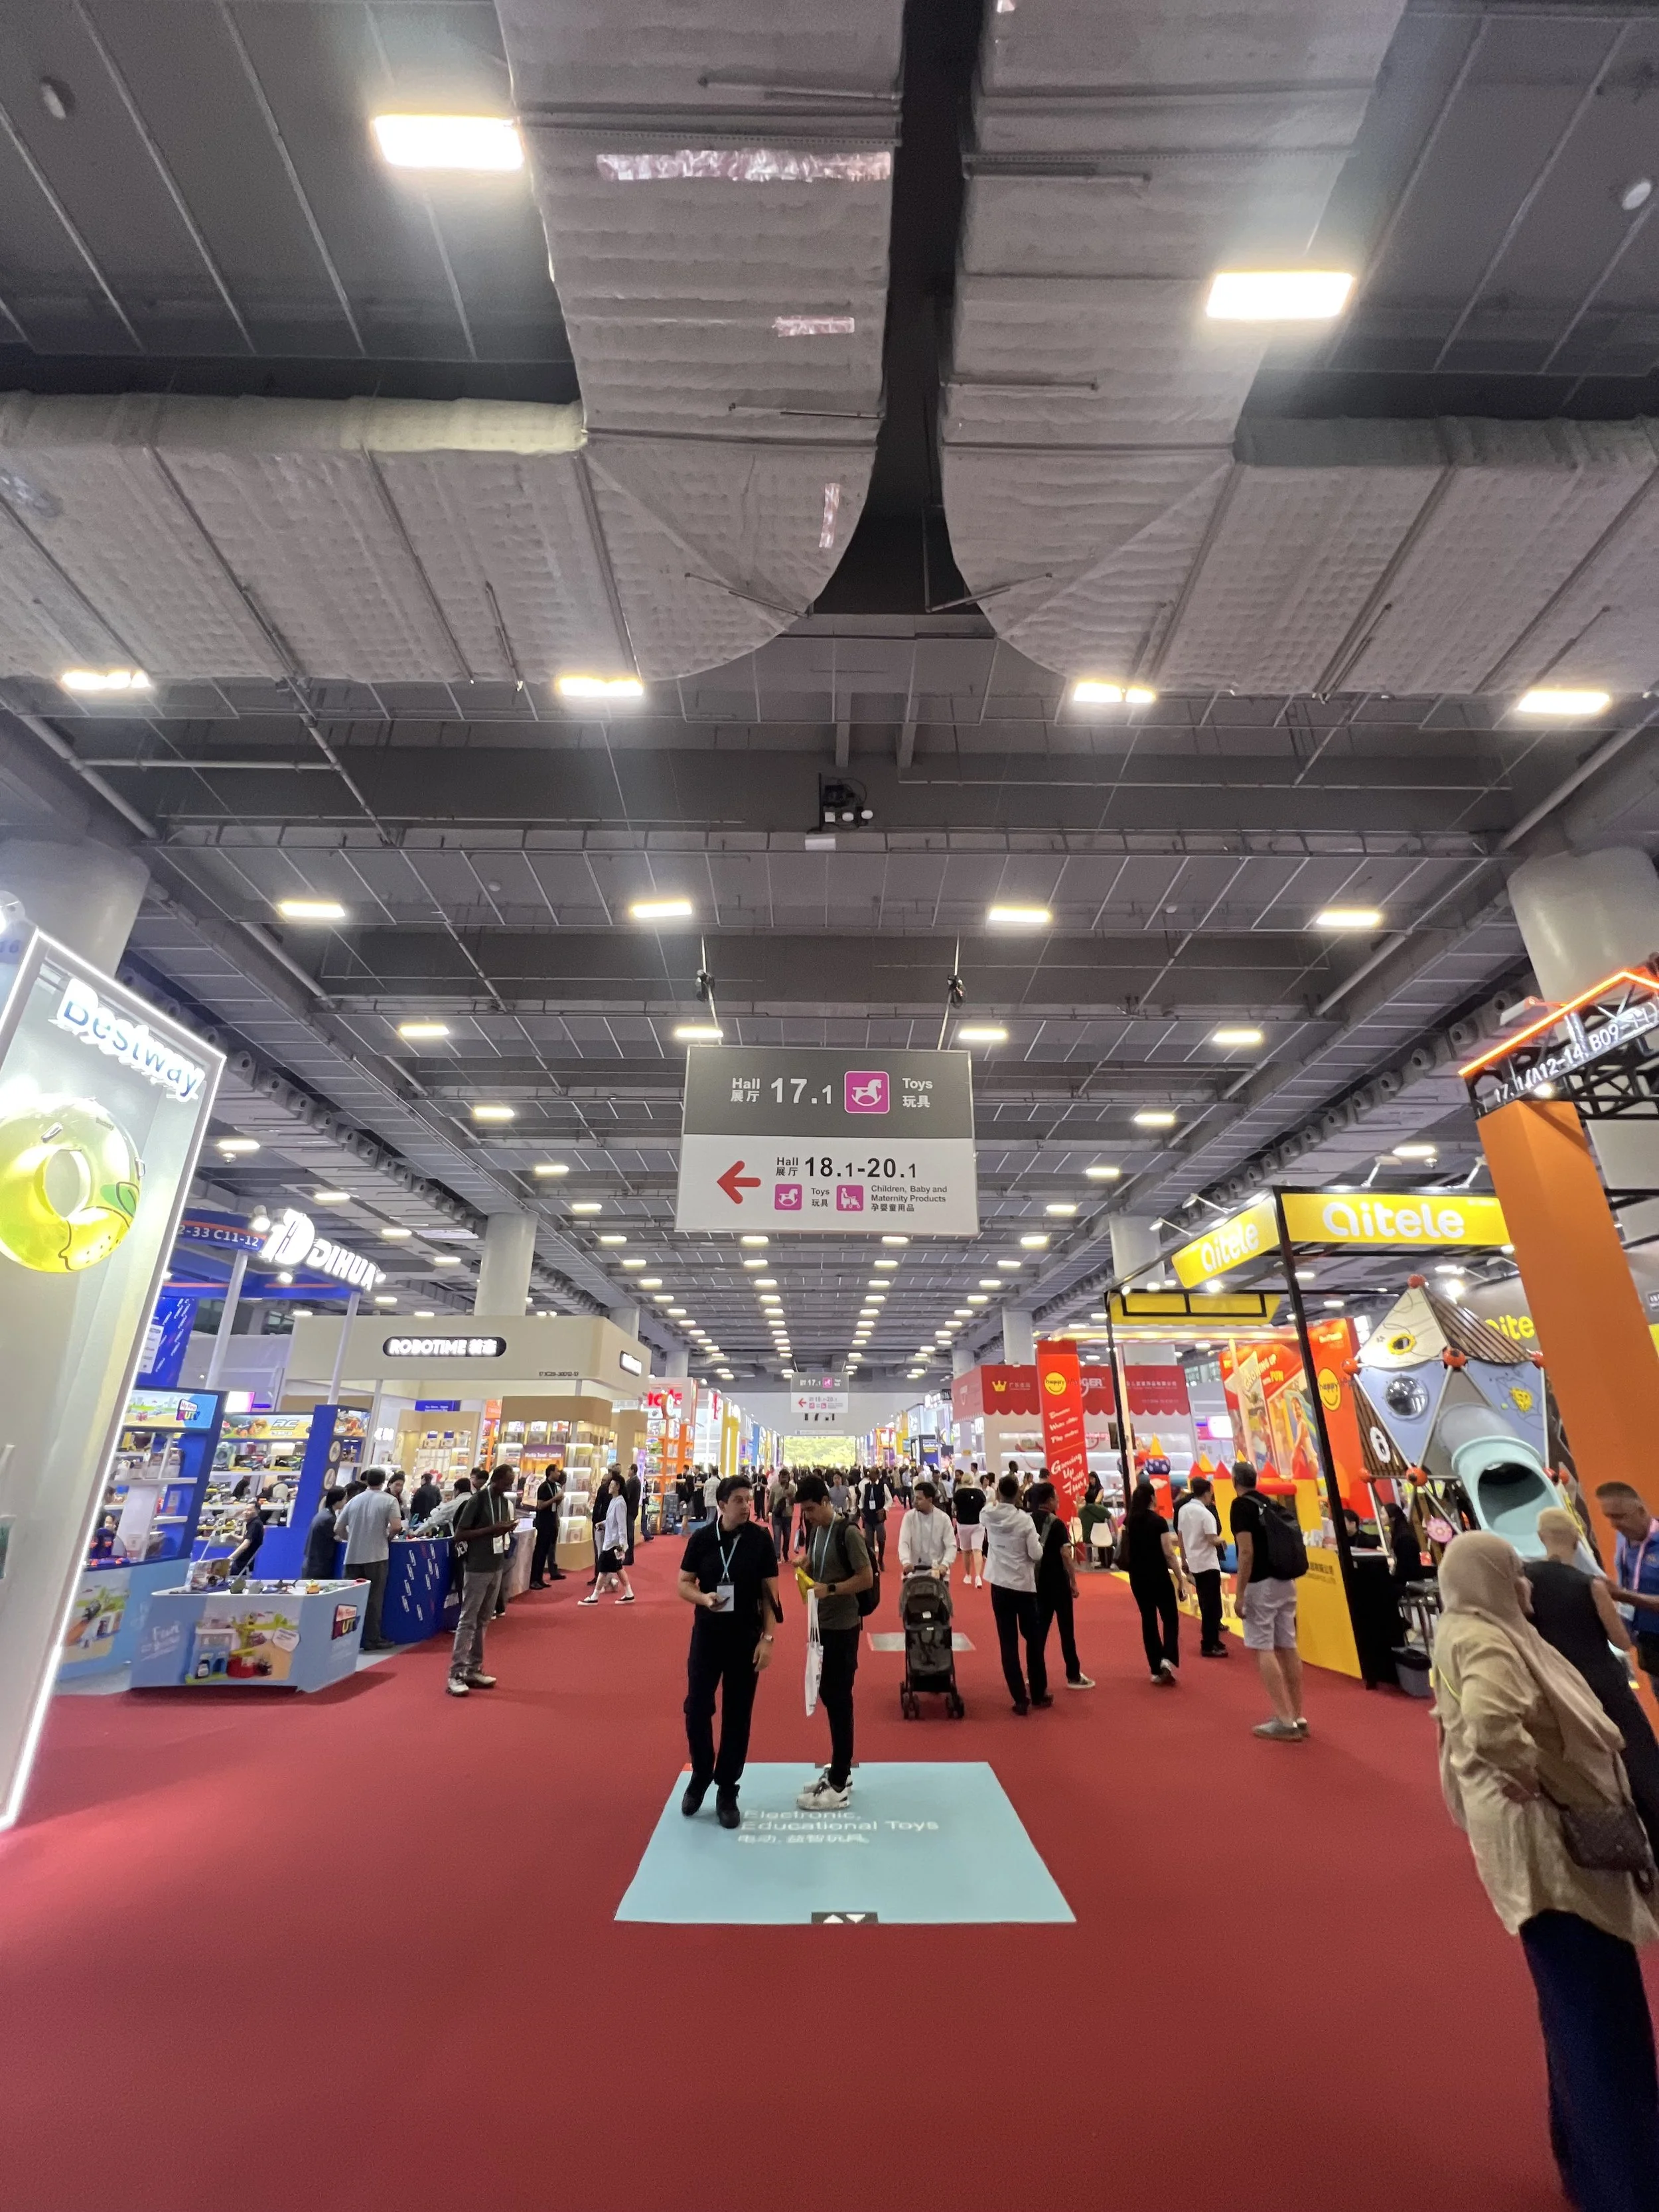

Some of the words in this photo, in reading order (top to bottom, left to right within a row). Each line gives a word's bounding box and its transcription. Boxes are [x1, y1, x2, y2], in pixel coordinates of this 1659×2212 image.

[732, 1078, 760, 1089] Hall
[770, 1078, 831, 1104] 17.1
[902, 1078, 933, 1092] Toys
[731, 1090, 760, 1102] 展厅
[902, 1095, 930, 1108] 玩具
[776, 1157, 798, 1165] Hall
[805, 1157, 916, 1178] 18.1-20.1
[776, 1167, 798, 1176] 展厅
[910, 1185, 930, 1194] Baby
[812, 1199, 829, 1207] 玩具
[871, 1194, 908, 1203] Maternity
[871, 1203, 914, 1212] 孕婴童用品
[177, 1224, 210, 1238] 2-33
[214, 1230, 259, 1247] C11-12
[388, 1338, 468, 1355] ROBOTIME
[741, 1820, 877, 1830] Educational
[885, 1820, 939, 1832] Toys
